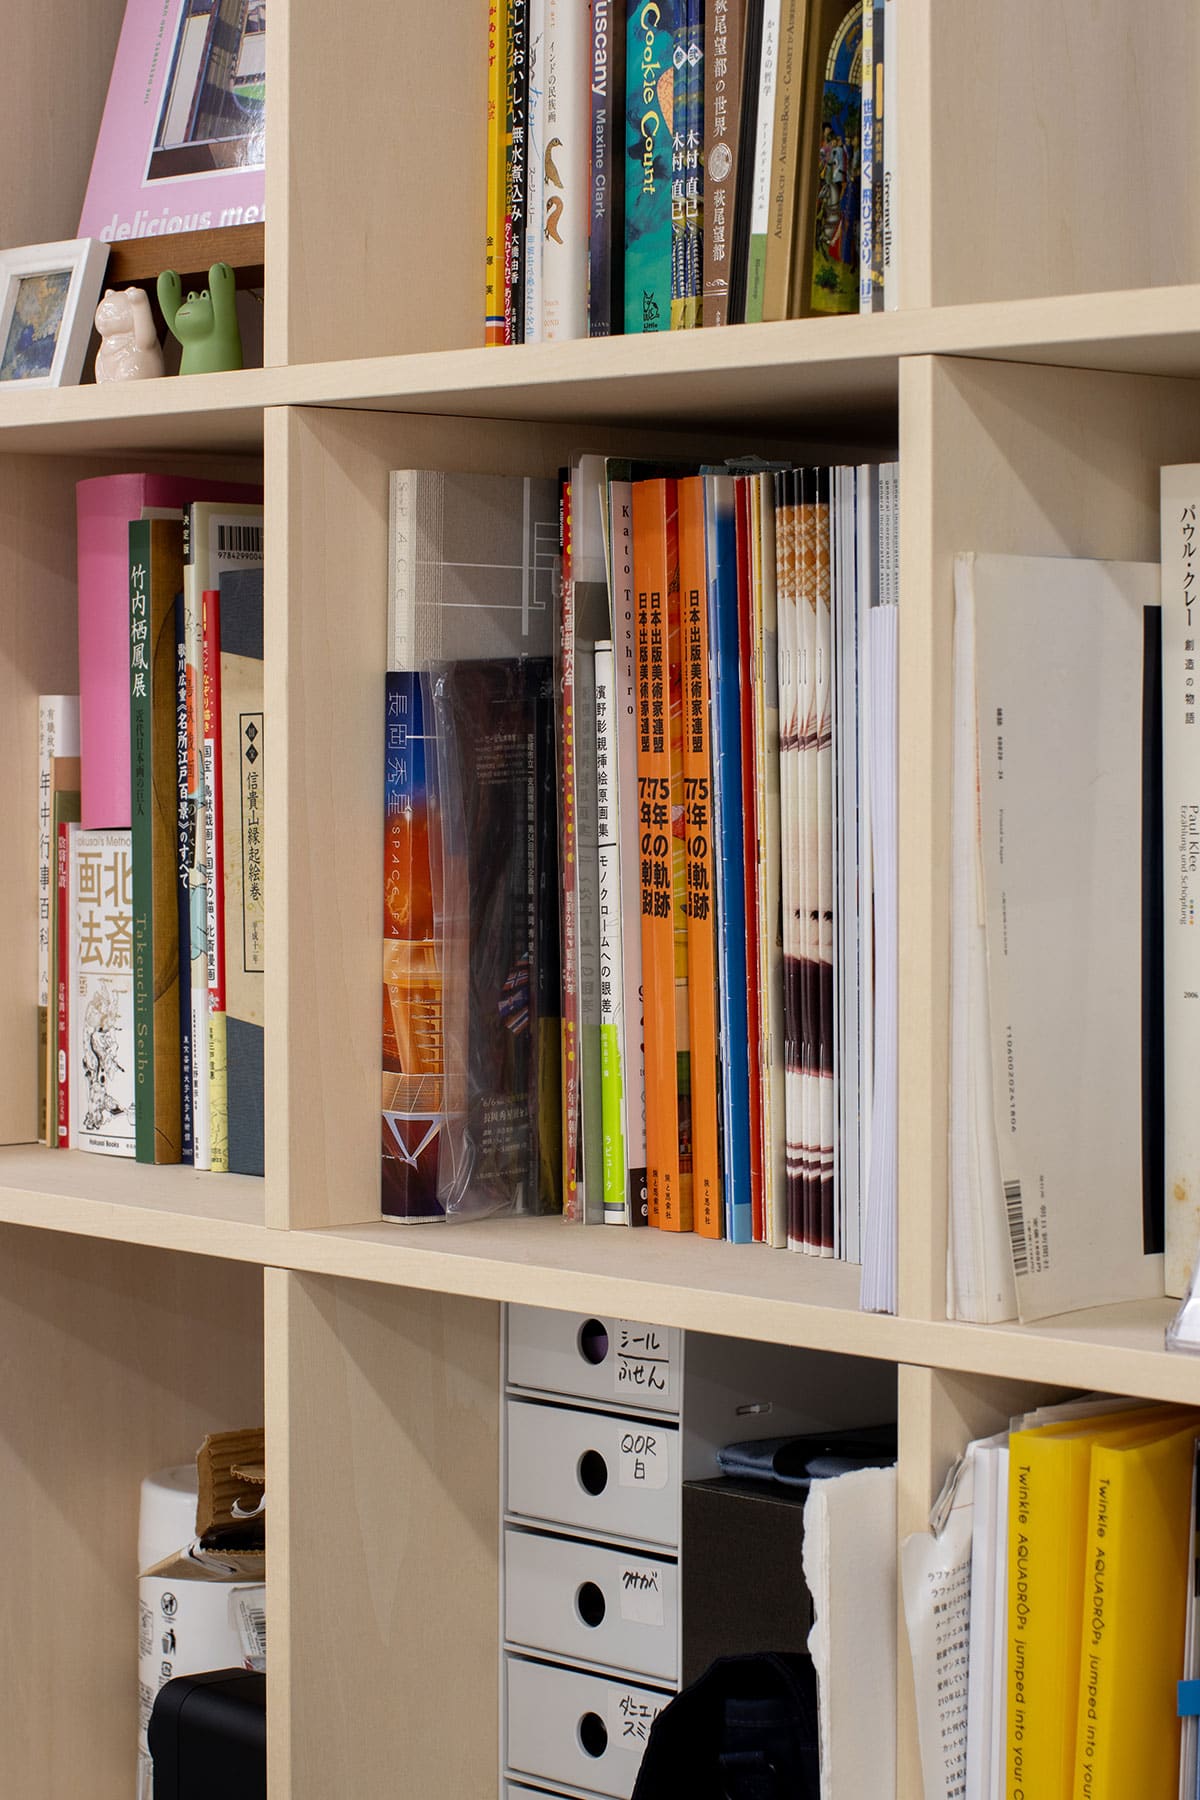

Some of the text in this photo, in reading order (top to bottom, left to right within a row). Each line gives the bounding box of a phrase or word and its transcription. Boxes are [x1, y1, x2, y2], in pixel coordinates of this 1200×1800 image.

[591, 0, 608, 218] uscany Maxine Clark
[640, 2, 661, 194] Cookie Count
[686, 129, 700, 218] 木村直巳
[100, 207, 212, 243] delicious
[712, 188, 728, 262] 萩尾望都
[884, 170, 894, 268] Greenwillow
[1180, 504, 1197, 628] パウル・クレー
[131, 563, 149, 698] 竹内栖鳳展
[621, 505, 635, 716] Kato Toshiro
[650, 591, 672, 919] 日本出版美術家連盟 75年の軌跡
[689, 591, 710, 921] 日本出版美術家連盟 75年の軌跡
[1188, 805, 1200, 873] Paul Klee
[77, 851, 104, 967] 画法
[103, 851, 134, 970] 北斎
[390, 826, 401, 1009] SPACE FANTASY
[135, 912, 149, 1085] Takeuchi Seiho
[617, 1360, 666, 1390] ふせん
[620, 1330, 661, 1351] シール
[620, 1433, 658, 1457] QOR
[1017, 1464, 1031, 1524] Twinkle
[1096, 1478, 1110, 1538] Twinkle
[622, 1569, 660, 1593] クサカベ
[1013, 1638, 1027, 1705] jumped
[1087, 1654, 1101, 1721] jumped
[1014, 1708, 1026, 1742] into
[1084, 1725, 1097, 1758] into
[1012, 1746, 1025, 1783] your
[1082, 1763, 1094, 1800] your
